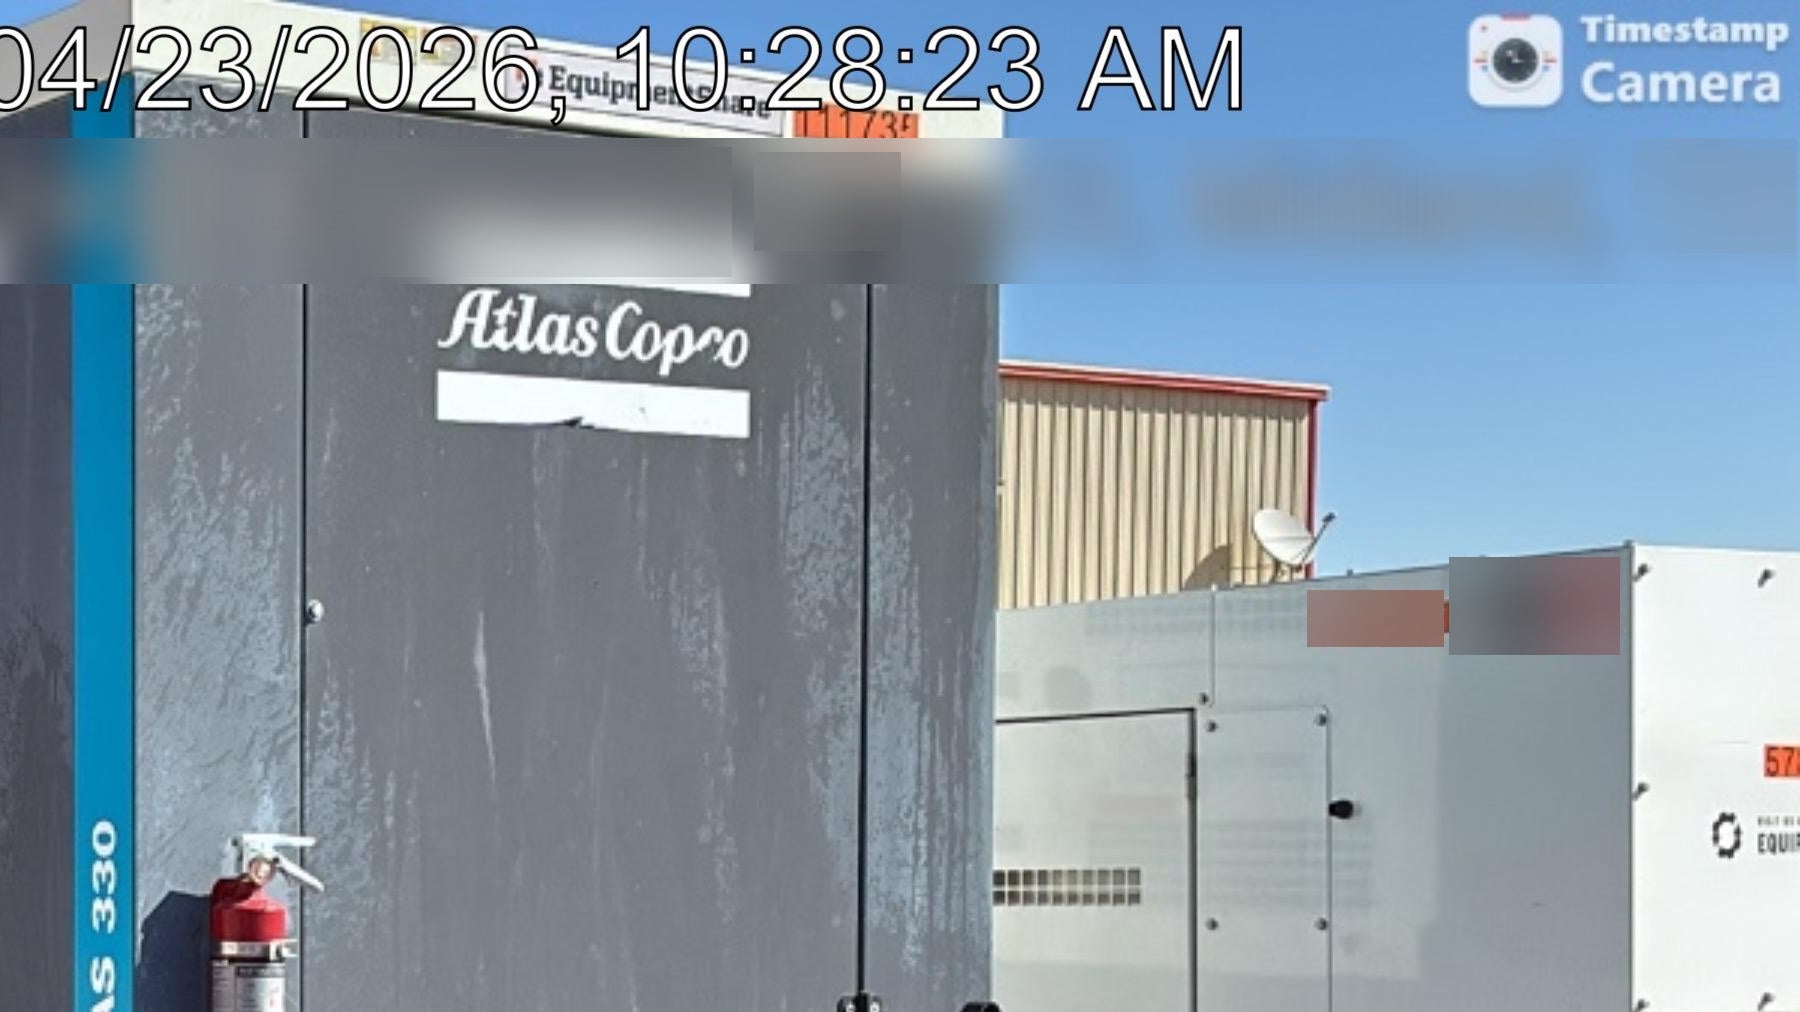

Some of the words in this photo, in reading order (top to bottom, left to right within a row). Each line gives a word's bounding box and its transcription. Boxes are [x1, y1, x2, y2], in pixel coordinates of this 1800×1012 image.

[548, 64, 772, 119] EquipeSae
[437, 287, 600, 358] Atlas
[1766, 746, 1800, 776] 57
[91, 820, 117, 934] 330
